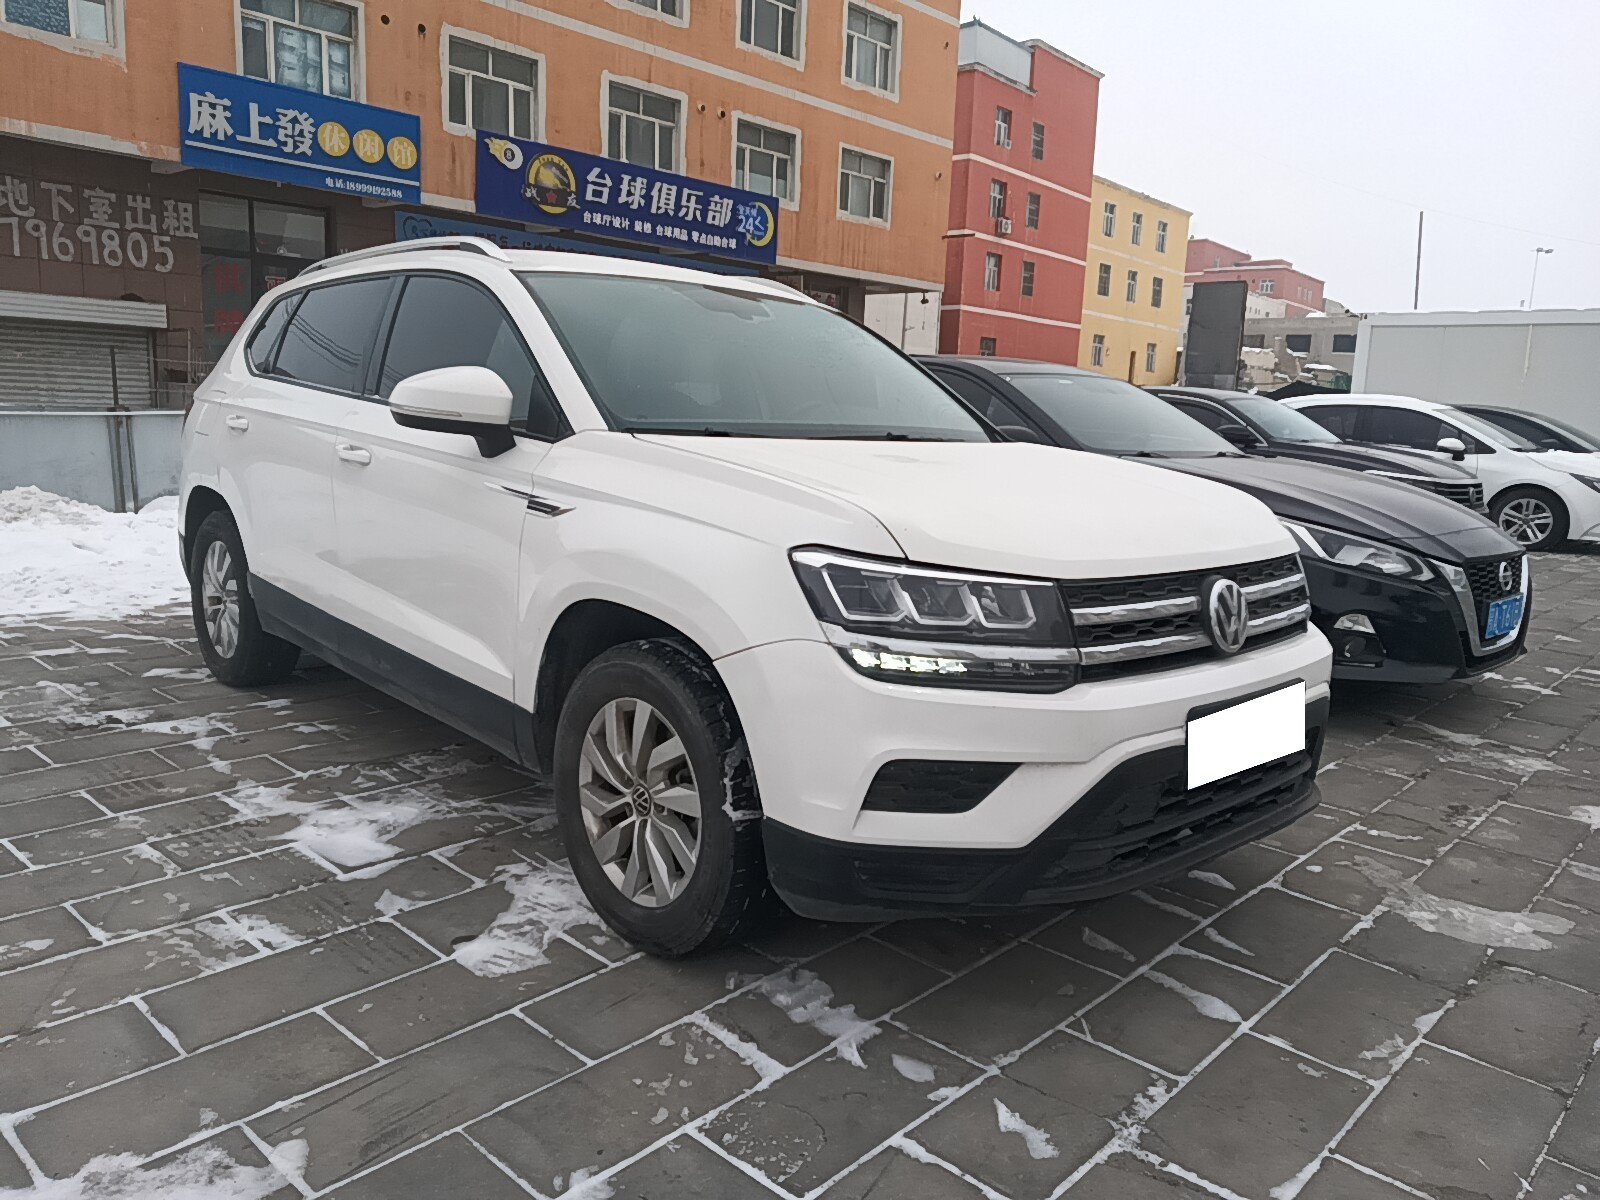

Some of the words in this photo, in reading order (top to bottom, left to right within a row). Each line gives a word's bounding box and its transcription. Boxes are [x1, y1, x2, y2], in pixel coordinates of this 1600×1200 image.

[188, 91, 316, 157] 麻上發
[0, 175, 199, 240] 地下室出租
[583, 210, 631, 231] 台球厅设计
[584, 166, 733, 228] 台球俱乐部
[0, 216, 175, 273] 7969805
